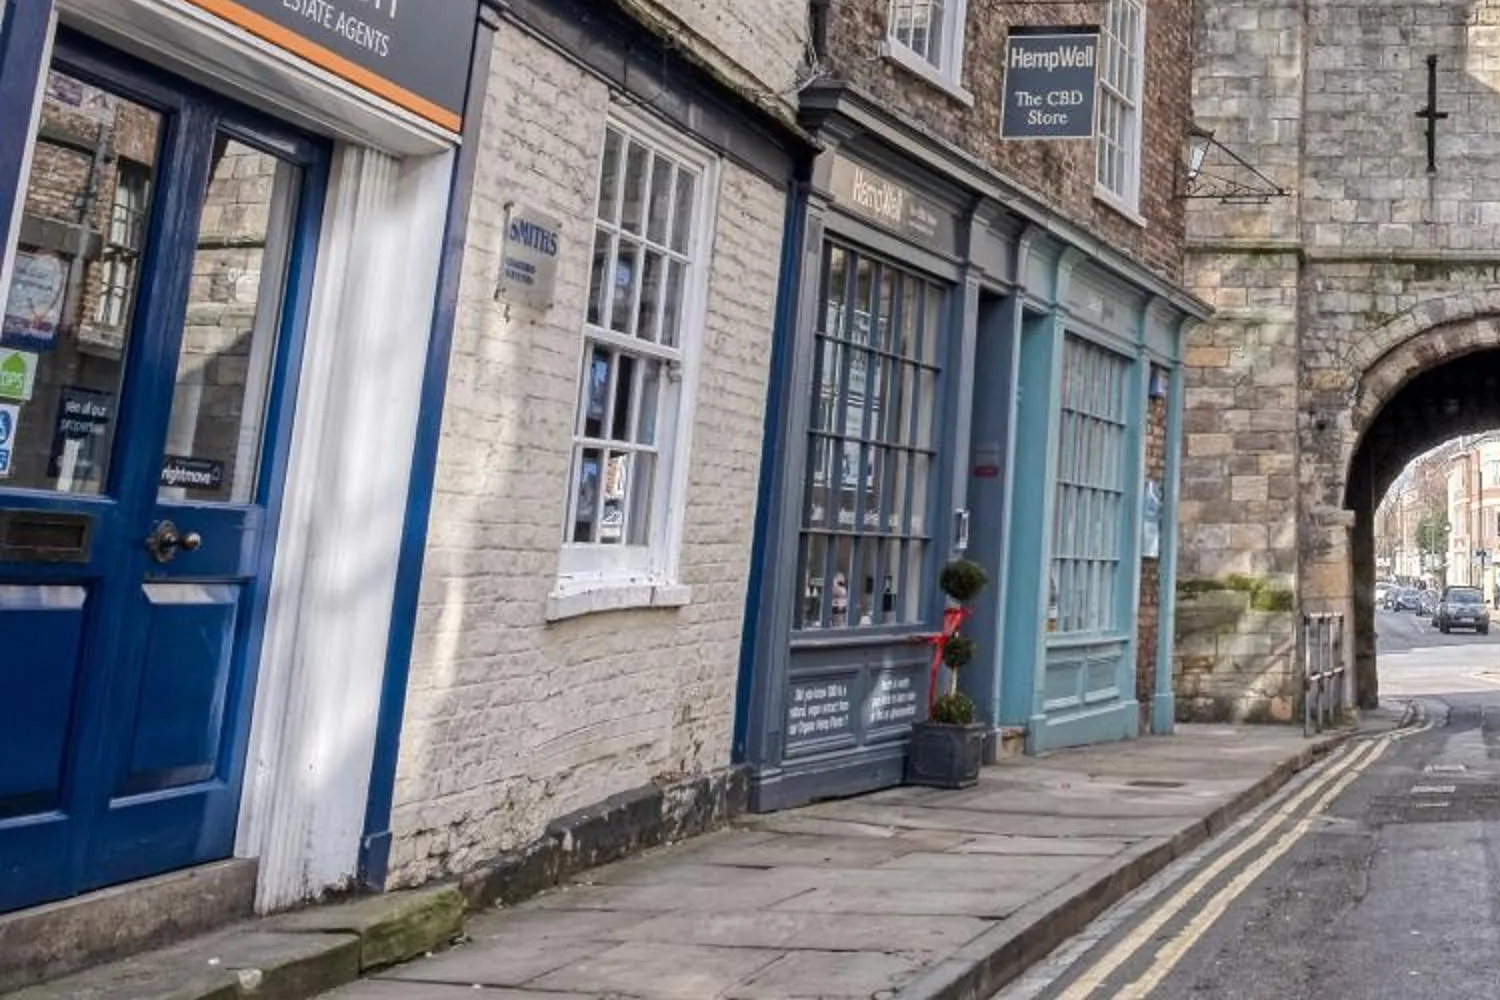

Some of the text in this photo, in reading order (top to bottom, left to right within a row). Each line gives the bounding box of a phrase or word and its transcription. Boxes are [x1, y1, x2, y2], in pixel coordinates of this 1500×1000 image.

[335, 11, 389, 57] AGENTS
[1010, 45, 1094, 72] HempWell
[1014, 90, 1083, 107] The CBD
[1027, 109, 1068, 125] Store
